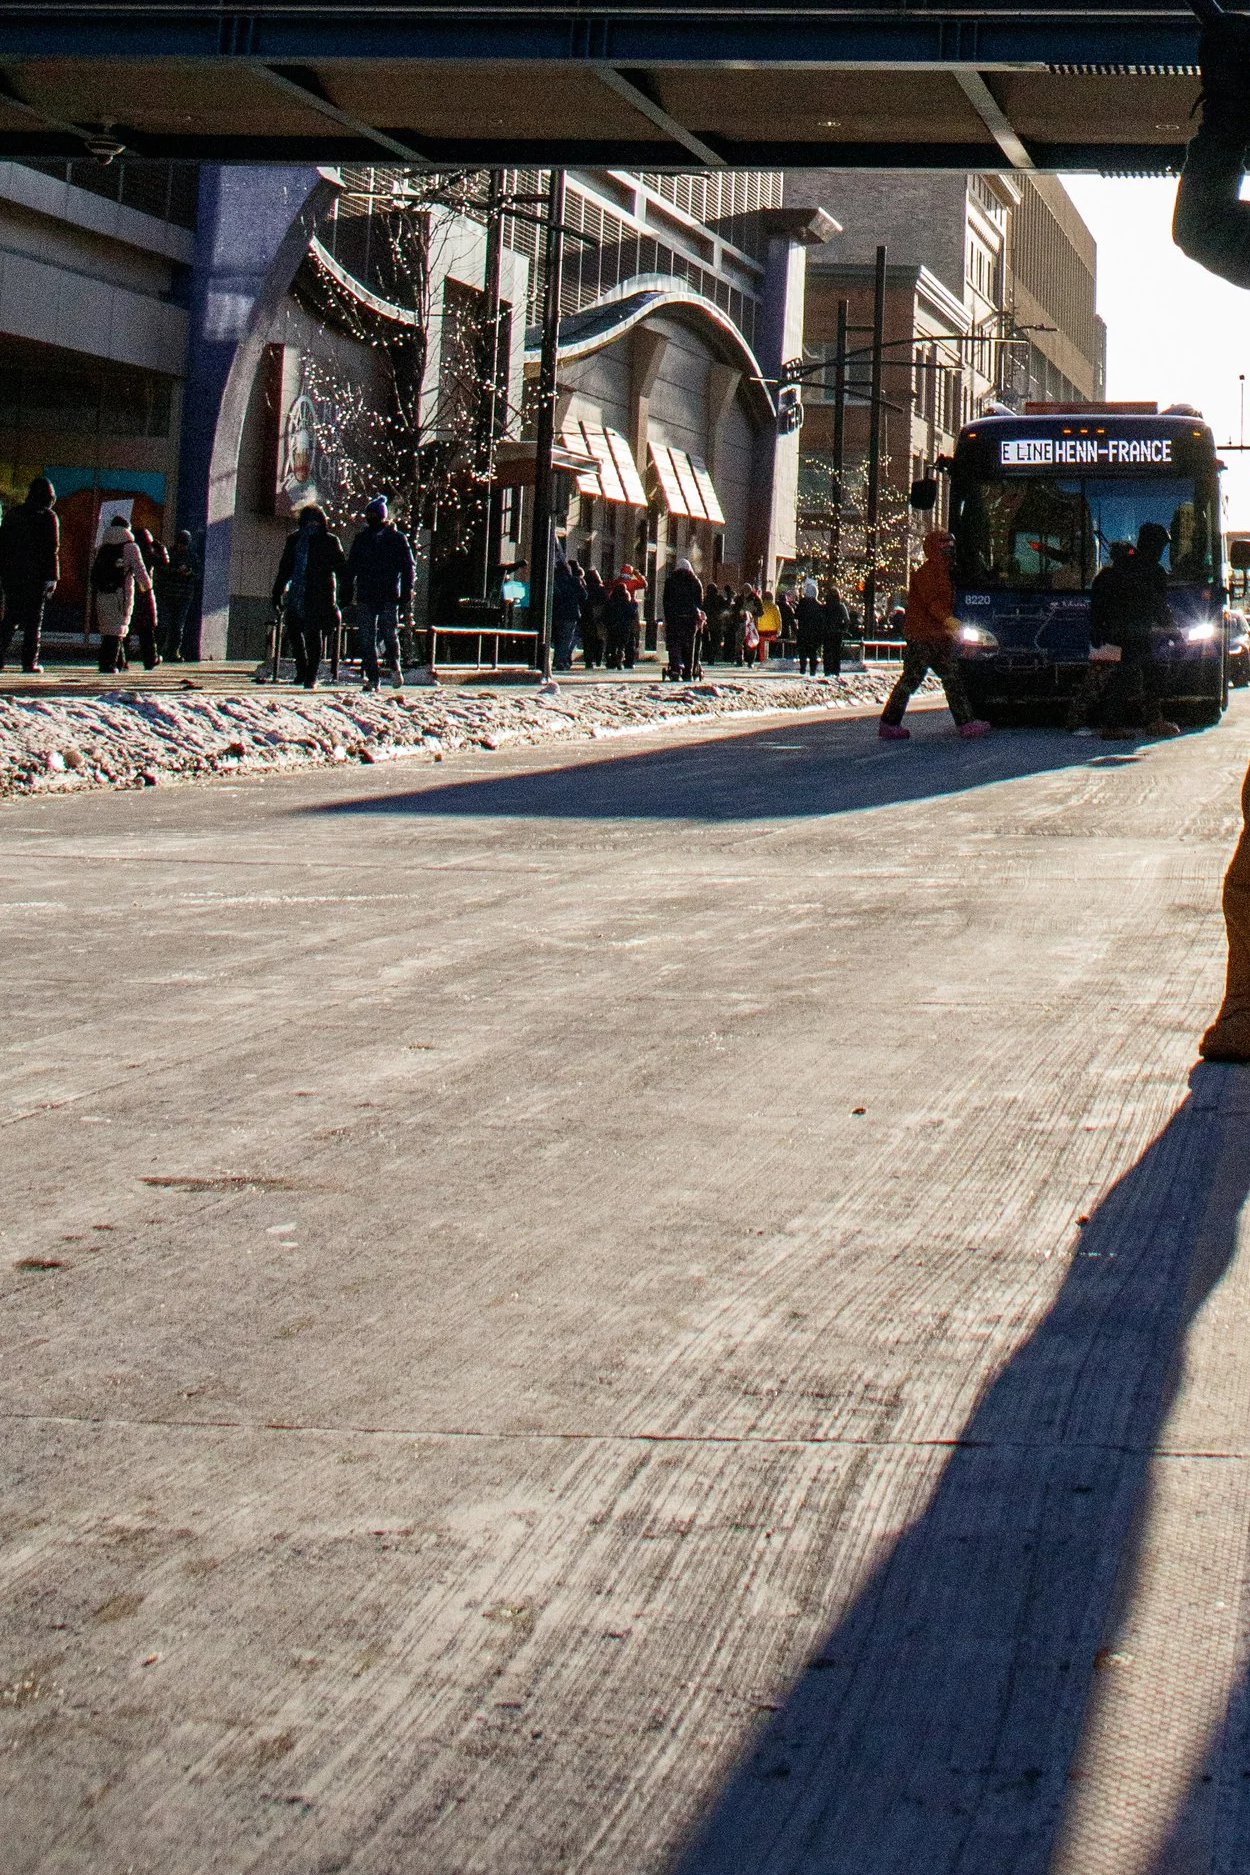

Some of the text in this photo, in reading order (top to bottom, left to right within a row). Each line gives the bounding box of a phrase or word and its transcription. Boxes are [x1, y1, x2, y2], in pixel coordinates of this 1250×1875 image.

[1002, 440, 1172, 462] E LINE HENN-FRANCE
[965, 595, 991, 605] 8220
